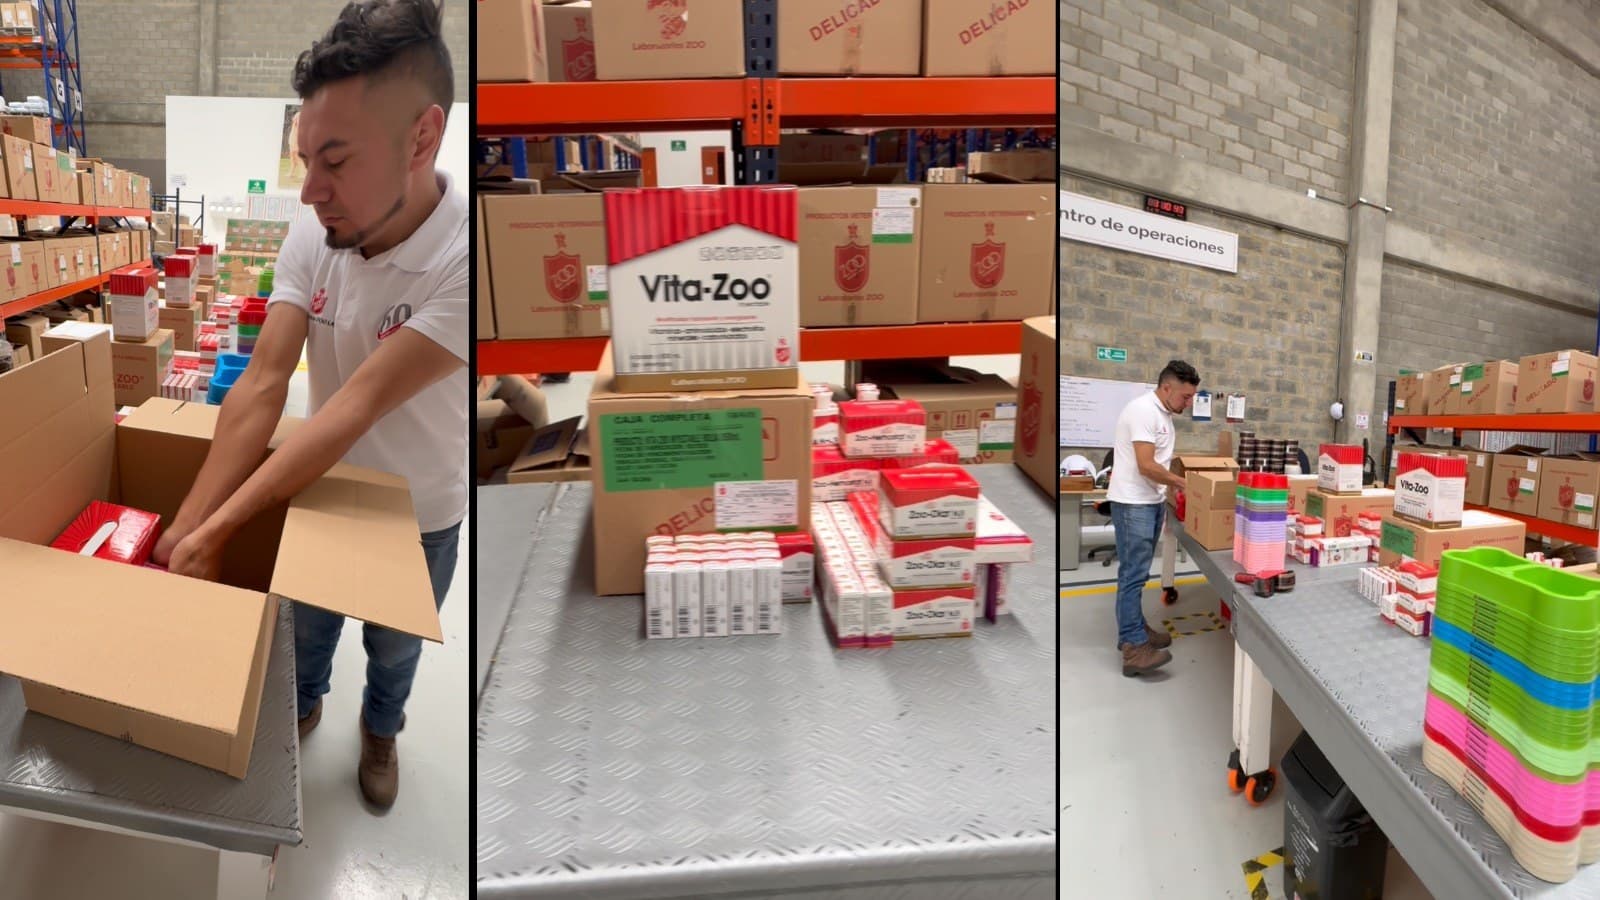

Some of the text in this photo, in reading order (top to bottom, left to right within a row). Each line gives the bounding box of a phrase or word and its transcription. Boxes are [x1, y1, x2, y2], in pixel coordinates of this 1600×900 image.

[1101, 217, 1124, 232] de
[1128, 225, 1225, 255] operaciones
[639, 272, 771, 303] Vita-Zoo
[614, 414, 643, 424] CAJA
[1400, 479, 1429, 495] Vita-Zoo
